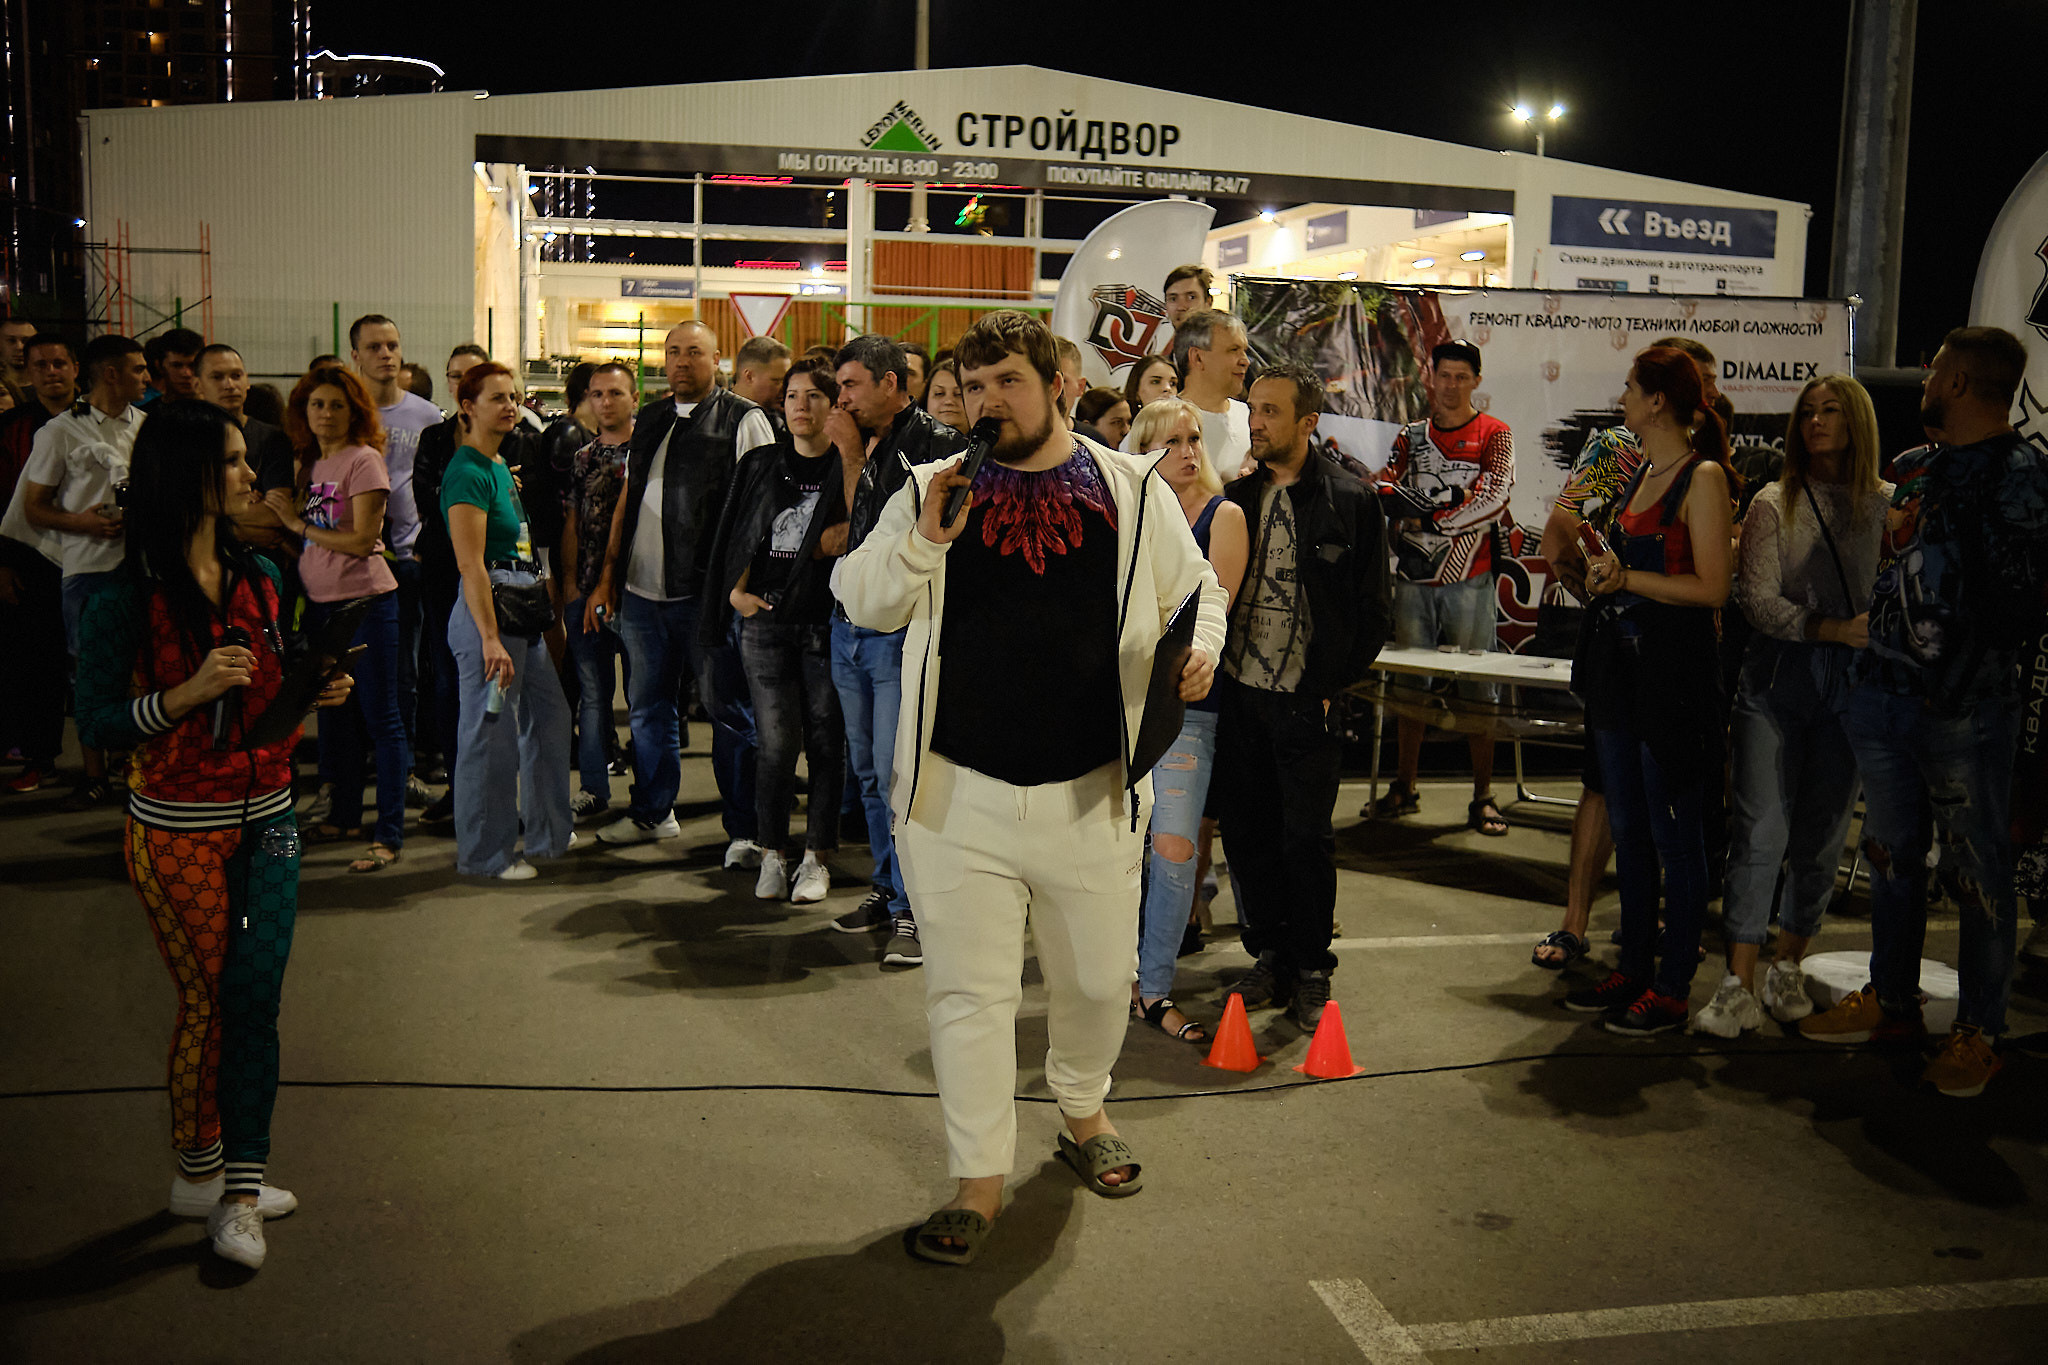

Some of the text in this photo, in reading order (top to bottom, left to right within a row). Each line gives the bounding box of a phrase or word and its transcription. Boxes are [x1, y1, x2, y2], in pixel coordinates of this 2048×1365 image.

[860, 99, 943, 151] LEROY MERLIN
[957, 109, 1181, 161] СТРОЙДВОР
[778, 152, 811, 171] МЫ
[814, 154, 899, 175] ОТКРЫТЫ
[901, 159, 938, 177] 8:00
[952, 161, 999, 180] 23:00
[1046, 165, 1250, 195] ПОКУПАЙТЕ ОНЛАЙН 24/7
[1644, 210, 1732, 247] Въезд
[1559, 252, 1597, 264] Схема
[1667, 260, 1763, 276] автотранспорта
[626, 281, 637, 294] 7
[1469, 312, 1823, 337] РЕМОНТ КВАДРО-МОТО ТЕХНИКИ ЛЮБОЙ СЛОЖНОСТИ
[1723, 360, 1819, 381] DIMALEX
